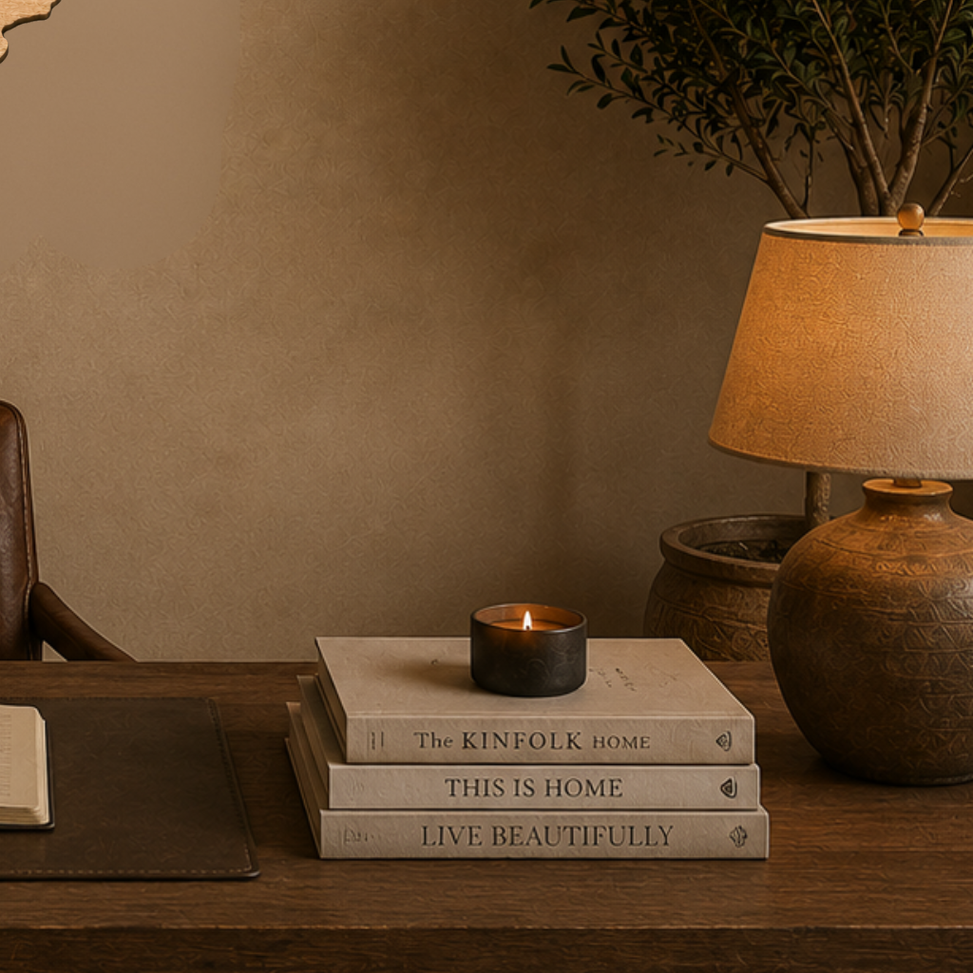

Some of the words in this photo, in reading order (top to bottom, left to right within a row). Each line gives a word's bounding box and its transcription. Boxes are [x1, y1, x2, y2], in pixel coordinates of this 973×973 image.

[413, 731, 454, 749] The
[462, 731, 582, 750] KINFOLK
[593, 735, 650, 750] HOME
[444, 778, 505, 798] THIS
[513, 778, 535, 798] IS
[545, 778, 623, 798] HOME
[422, 825, 483, 846] LIVE
[492, 825, 673, 847] BEAUTIFULLY
